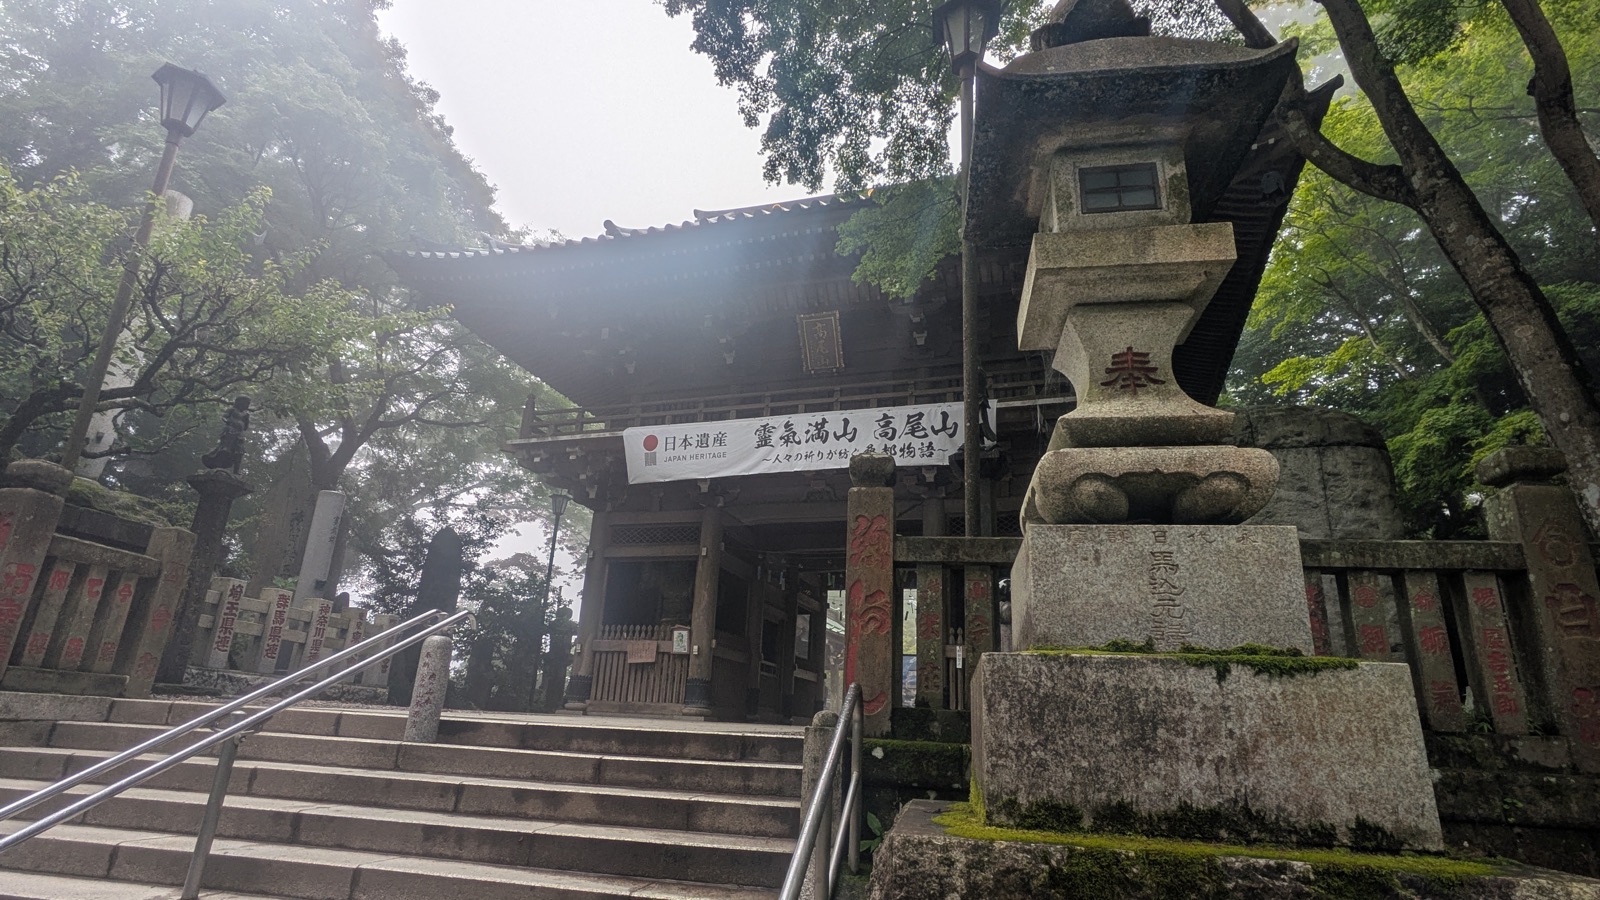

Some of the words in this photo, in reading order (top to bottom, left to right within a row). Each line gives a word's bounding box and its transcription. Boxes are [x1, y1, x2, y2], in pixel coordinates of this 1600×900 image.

[873, 410, 959, 441] 高尾山
[664, 431, 728, 452] 日本遺産
[664, 454, 687, 463] JAPAN
[689, 451, 728, 461] HERITAGE
[214, 584, 244, 653] 埼玉県連
[264, 593, 291, 660] 群馬県連
